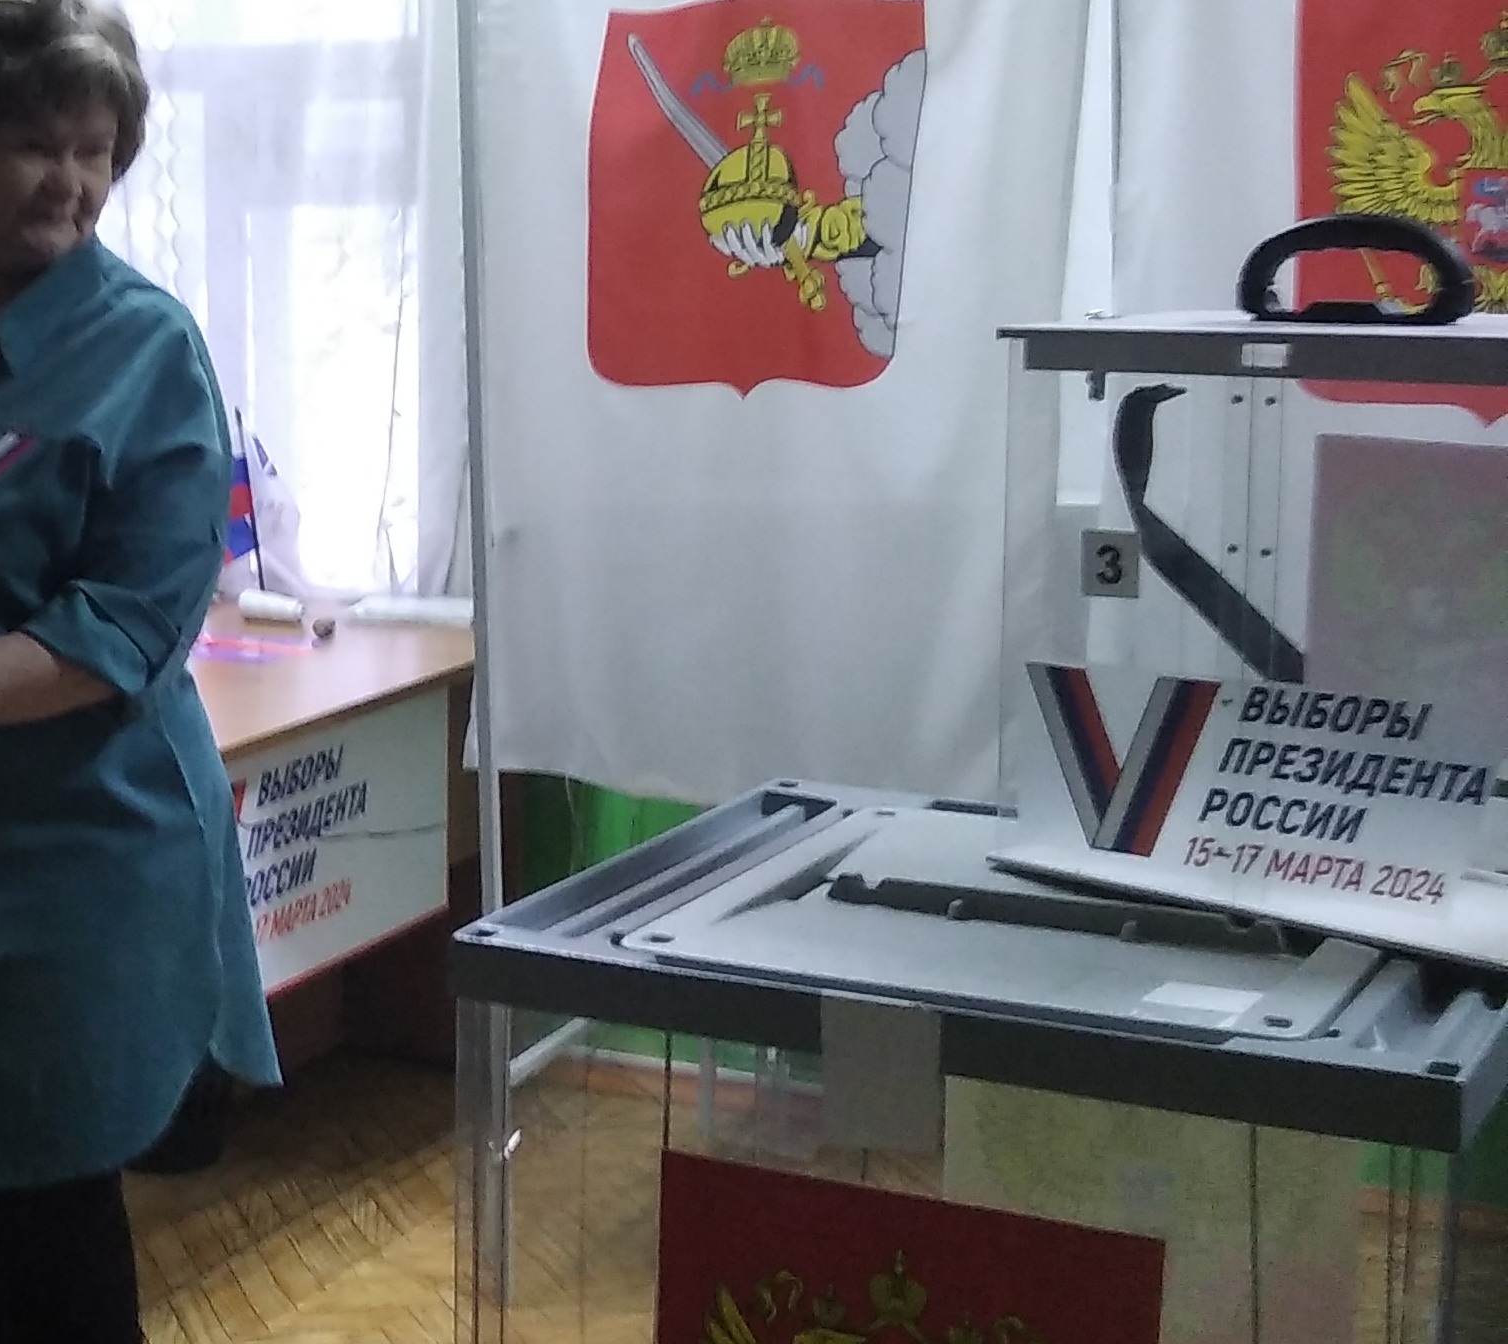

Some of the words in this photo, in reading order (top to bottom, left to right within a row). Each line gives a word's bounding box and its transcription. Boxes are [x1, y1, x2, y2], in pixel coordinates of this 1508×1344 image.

[1095, 544, 1123, 586] 3
[1237, 685, 1434, 742] ВЫБОРЫ
[256, 743, 345, 807] ВЫБОРЫ
[1217, 737, 1490, 806] ПРЕЗИДЕНТА
[246, 779, 368, 860] ПРЕЗИДЕНТА
[1197, 787, 1369, 845] РОССИИ
[1264, 847, 1367, 894] МАРТА
[1369, 863, 1446, 906] 2024
